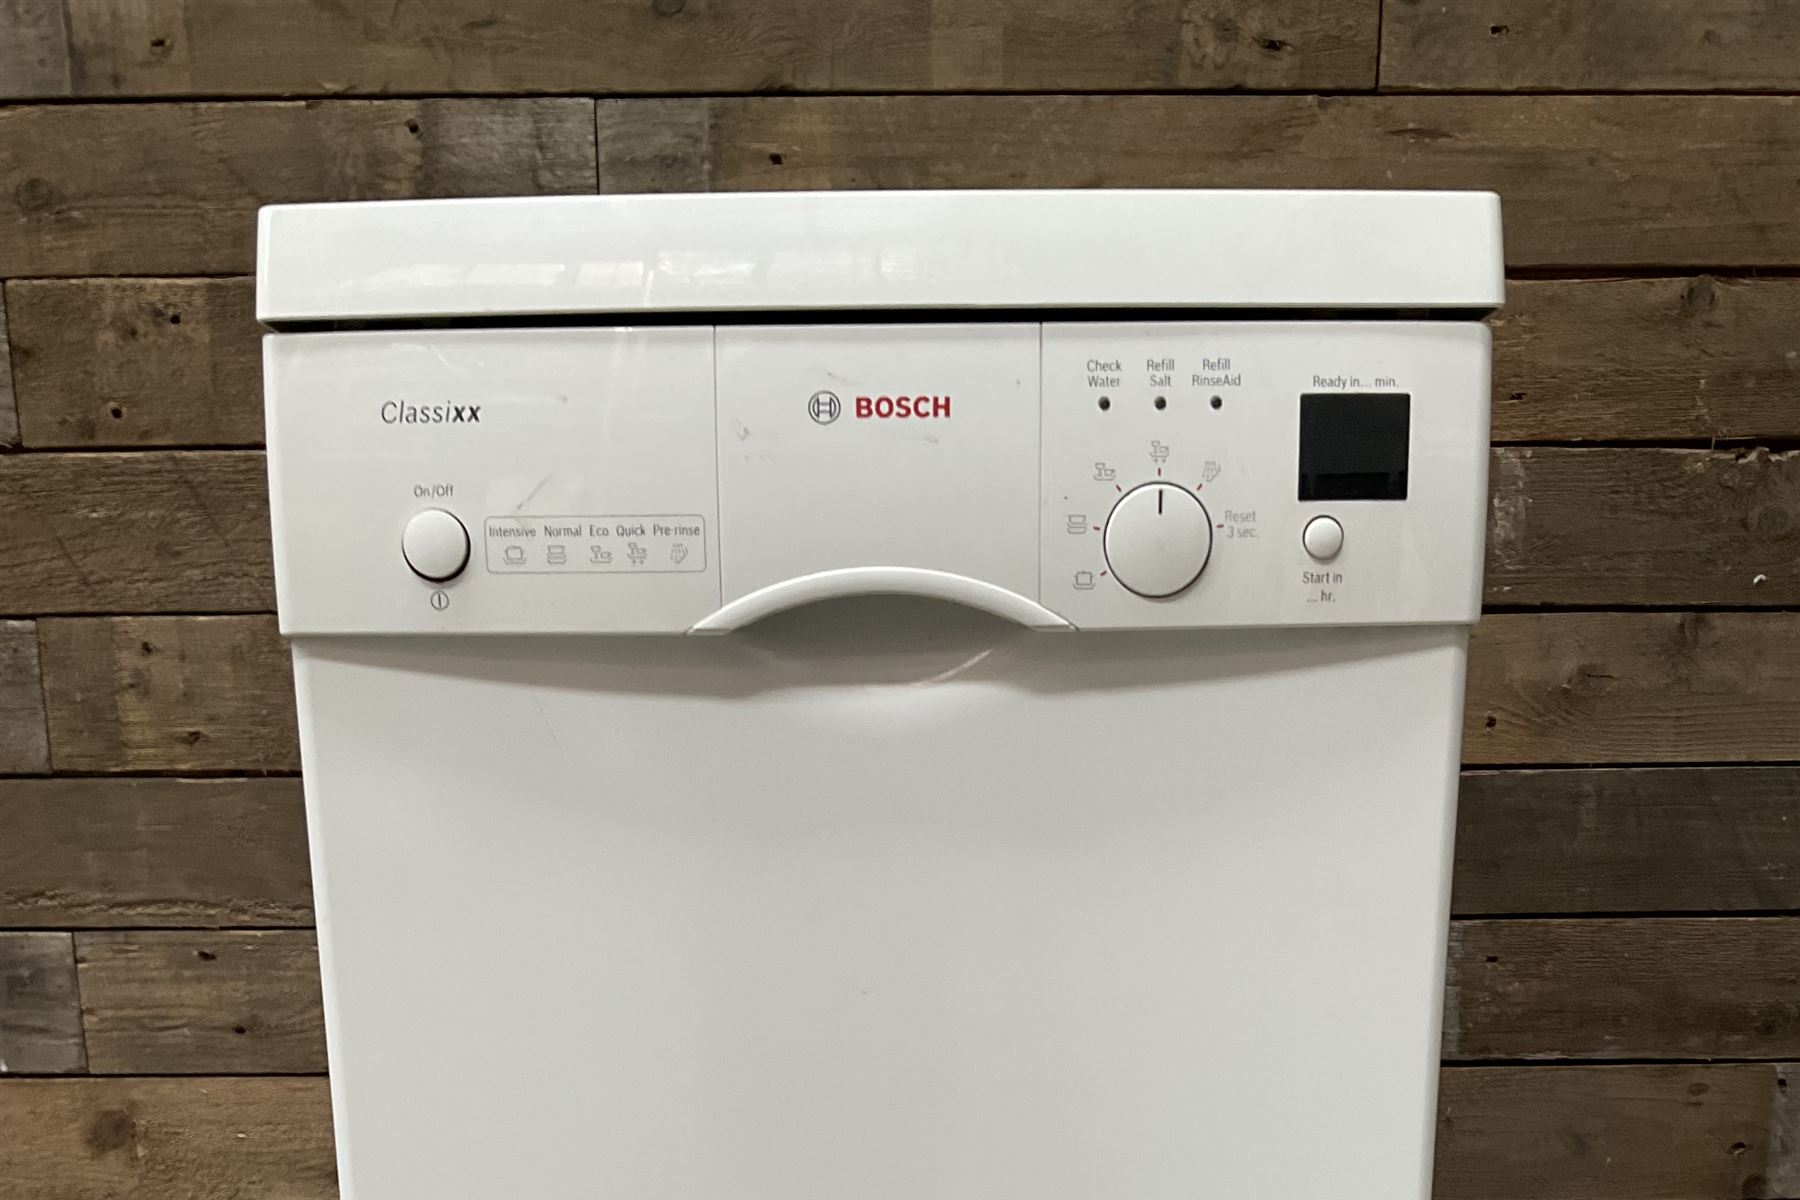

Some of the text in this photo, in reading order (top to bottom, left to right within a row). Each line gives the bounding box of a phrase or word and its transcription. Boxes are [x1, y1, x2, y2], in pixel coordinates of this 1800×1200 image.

[1087, 359, 1122, 372] Check
[1147, 359, 1175, 371] Refill
[1203, 358, 1231, 371] Refill
[1088, 375, 1121, 388] Water
[1150, 374, 1172, 387] Salt
[1313, 375, 1347, 390] Ready
[1375, 375, 1399, 388] min.
[381, 400, 482, 424] Classixx
[855, 396, 951, 418] BOSCH
[414, 484, 454, 498] On/Off
[1224, 510, 1257, 523] Reset
[489, 524, 537, 538] Intensive
[544, 524, 582, 537] Normal
[589, 524, 609, 537] Eco
[616, 523, 646, 538] Quick
[653, 523, 701, 537] Pre-rinse
[1236, 526, 1260, 538] sec.
[1302, 571, 1343, 584] Start in
[1320, 590, 1336, 602] hr.
